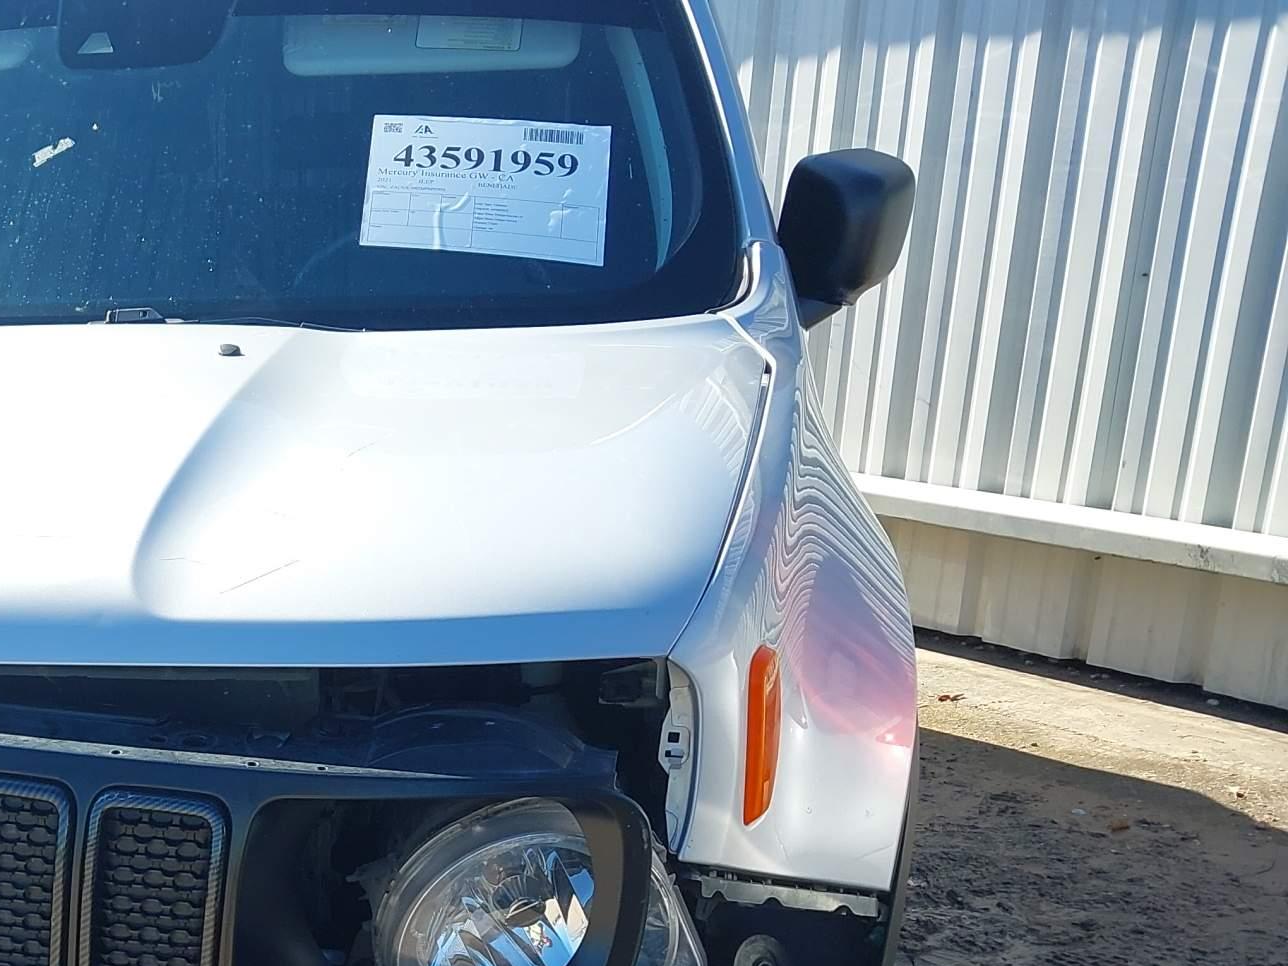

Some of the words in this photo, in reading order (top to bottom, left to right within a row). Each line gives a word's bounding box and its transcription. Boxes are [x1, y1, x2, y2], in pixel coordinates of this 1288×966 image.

[393, 144, 579, 177] 43591959
[377, 167, 418, 177] Mercury
[421, 169, 467, 179] Insurance
[469, 172, 489, 180] GW
